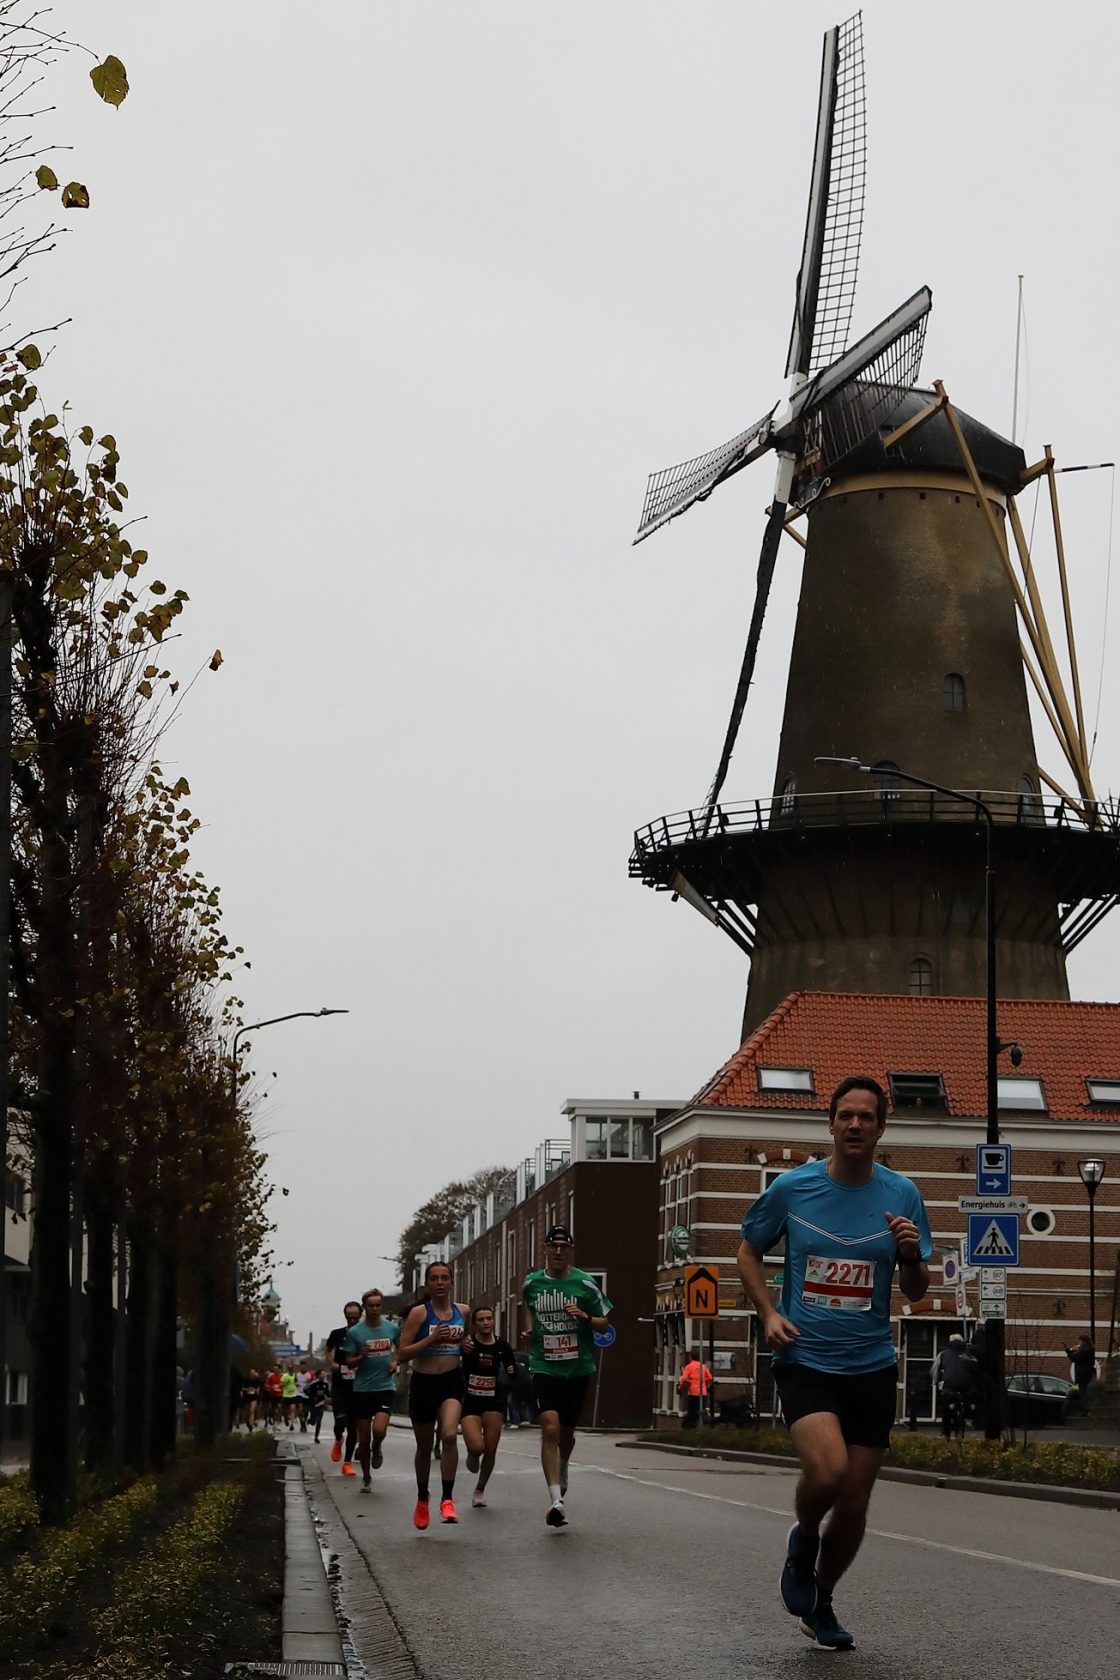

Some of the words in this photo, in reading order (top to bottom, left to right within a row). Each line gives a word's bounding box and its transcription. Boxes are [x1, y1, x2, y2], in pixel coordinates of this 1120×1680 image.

[961, 1200, 1006, 1210] Energiehuis
[826, 1262, 871, 1286] 2271
[695, 1289, 708, 1309] N
[556, 1335, 571, 1347] 141
